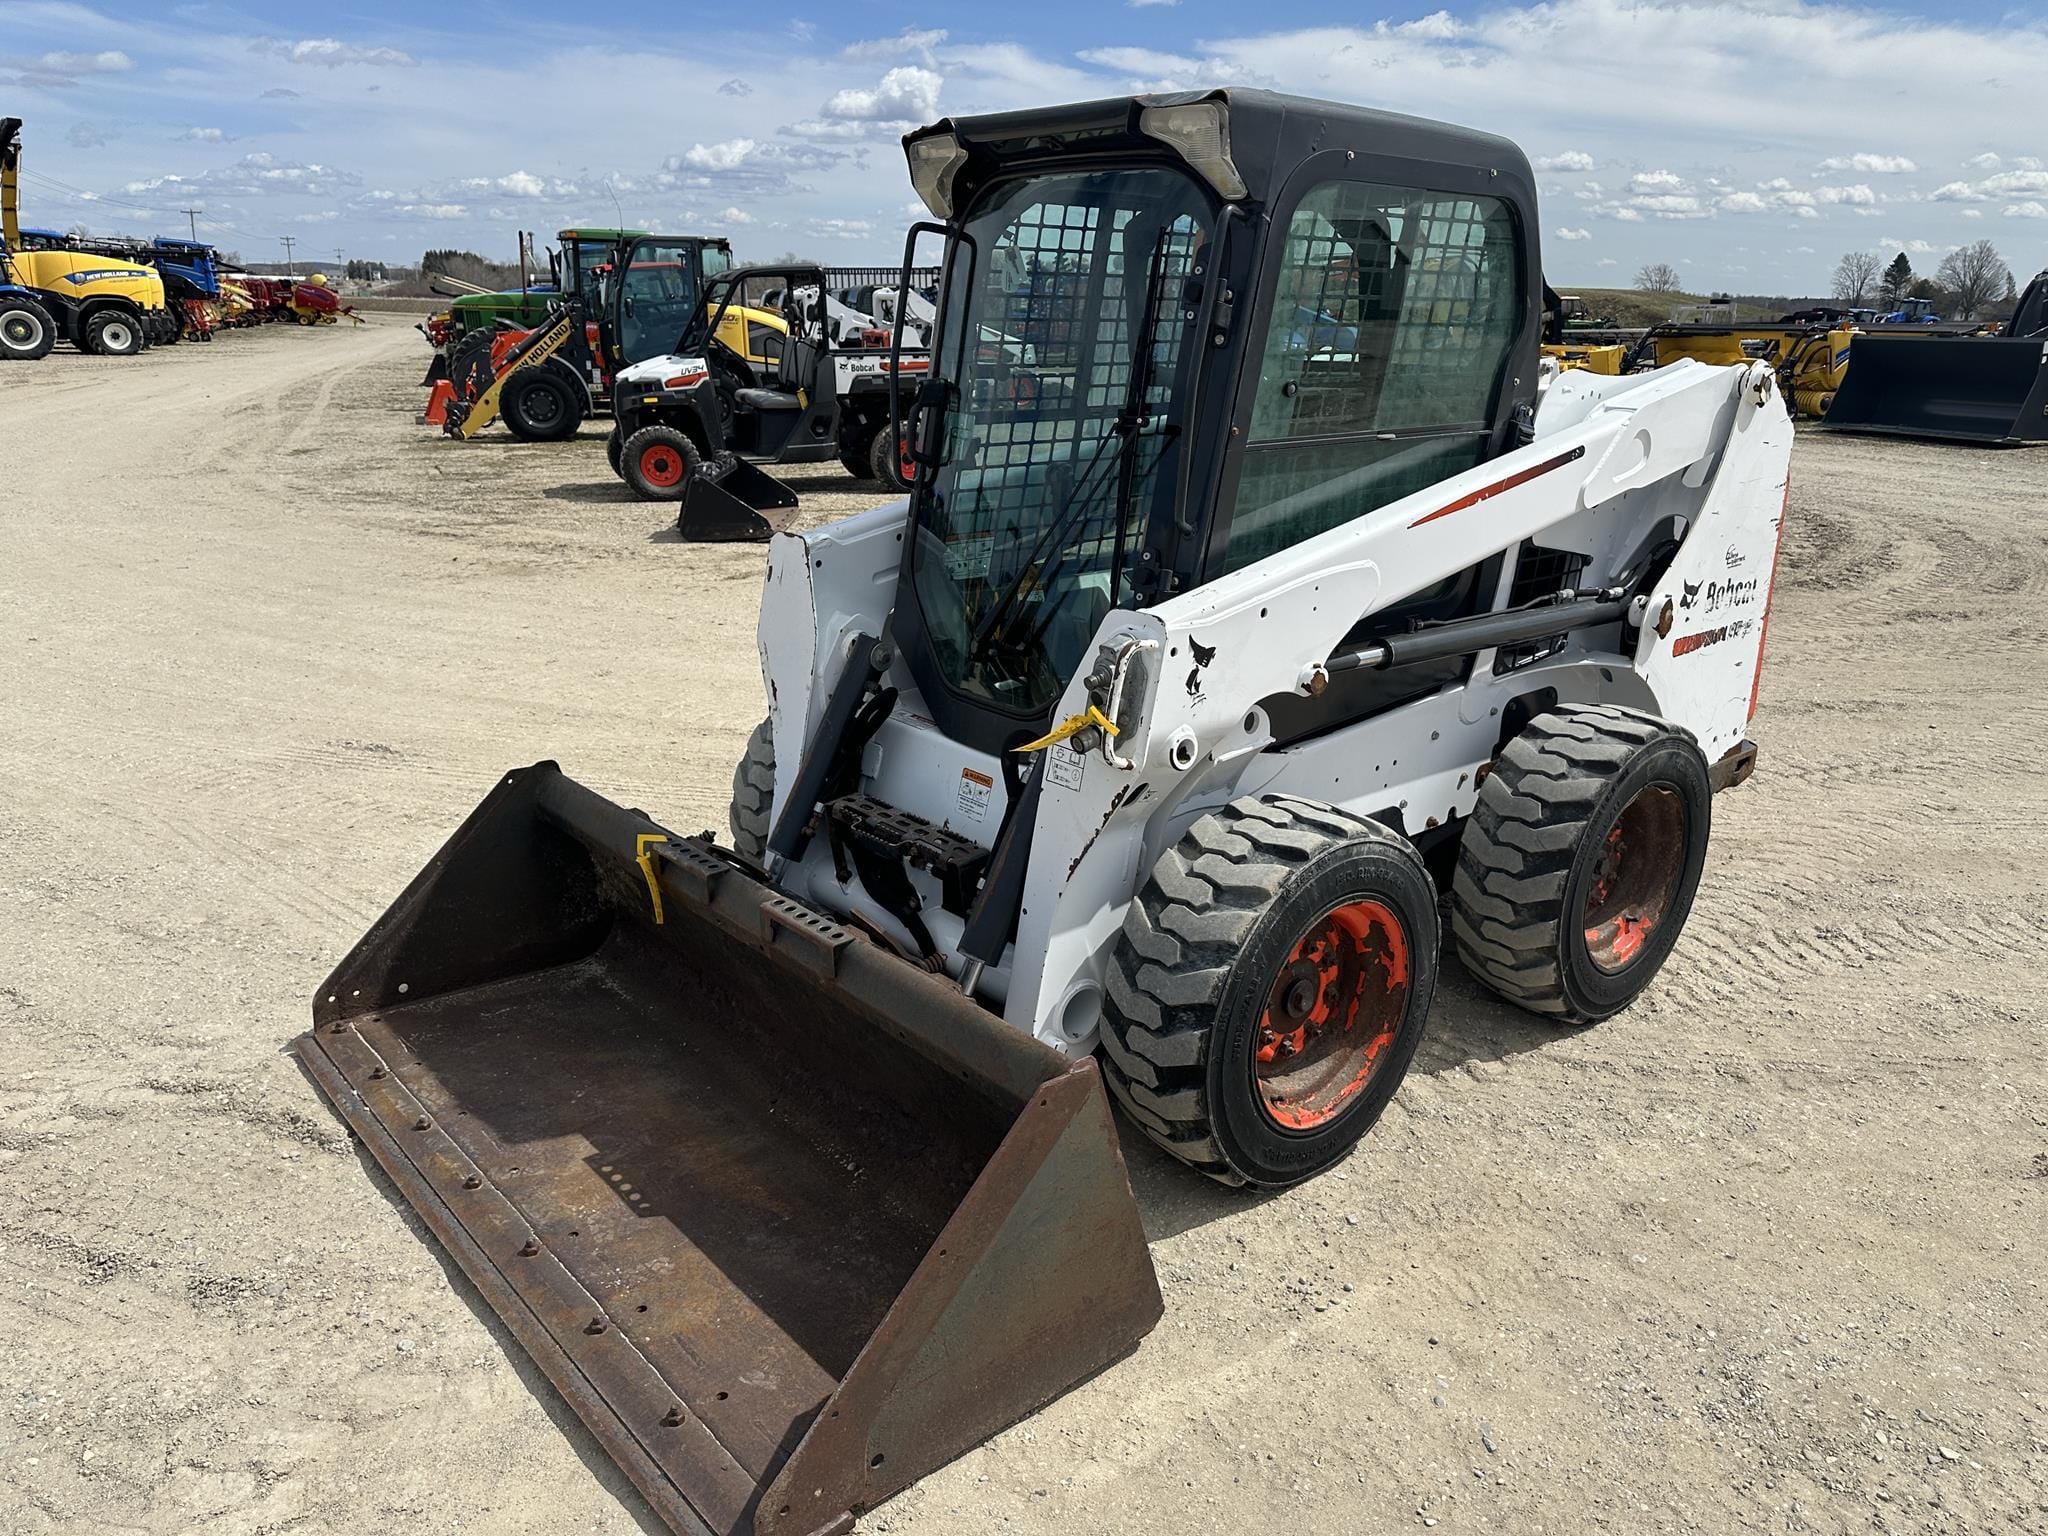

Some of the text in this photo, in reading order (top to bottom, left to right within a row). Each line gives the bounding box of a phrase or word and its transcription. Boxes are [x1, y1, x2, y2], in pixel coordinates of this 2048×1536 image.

[528, 323, 569, 363] HOLLAND
[681, 364, 704, 375] UV34
[851, 364, 875, 372] Bobcat
[969, 772, 991, 785] WARNING
